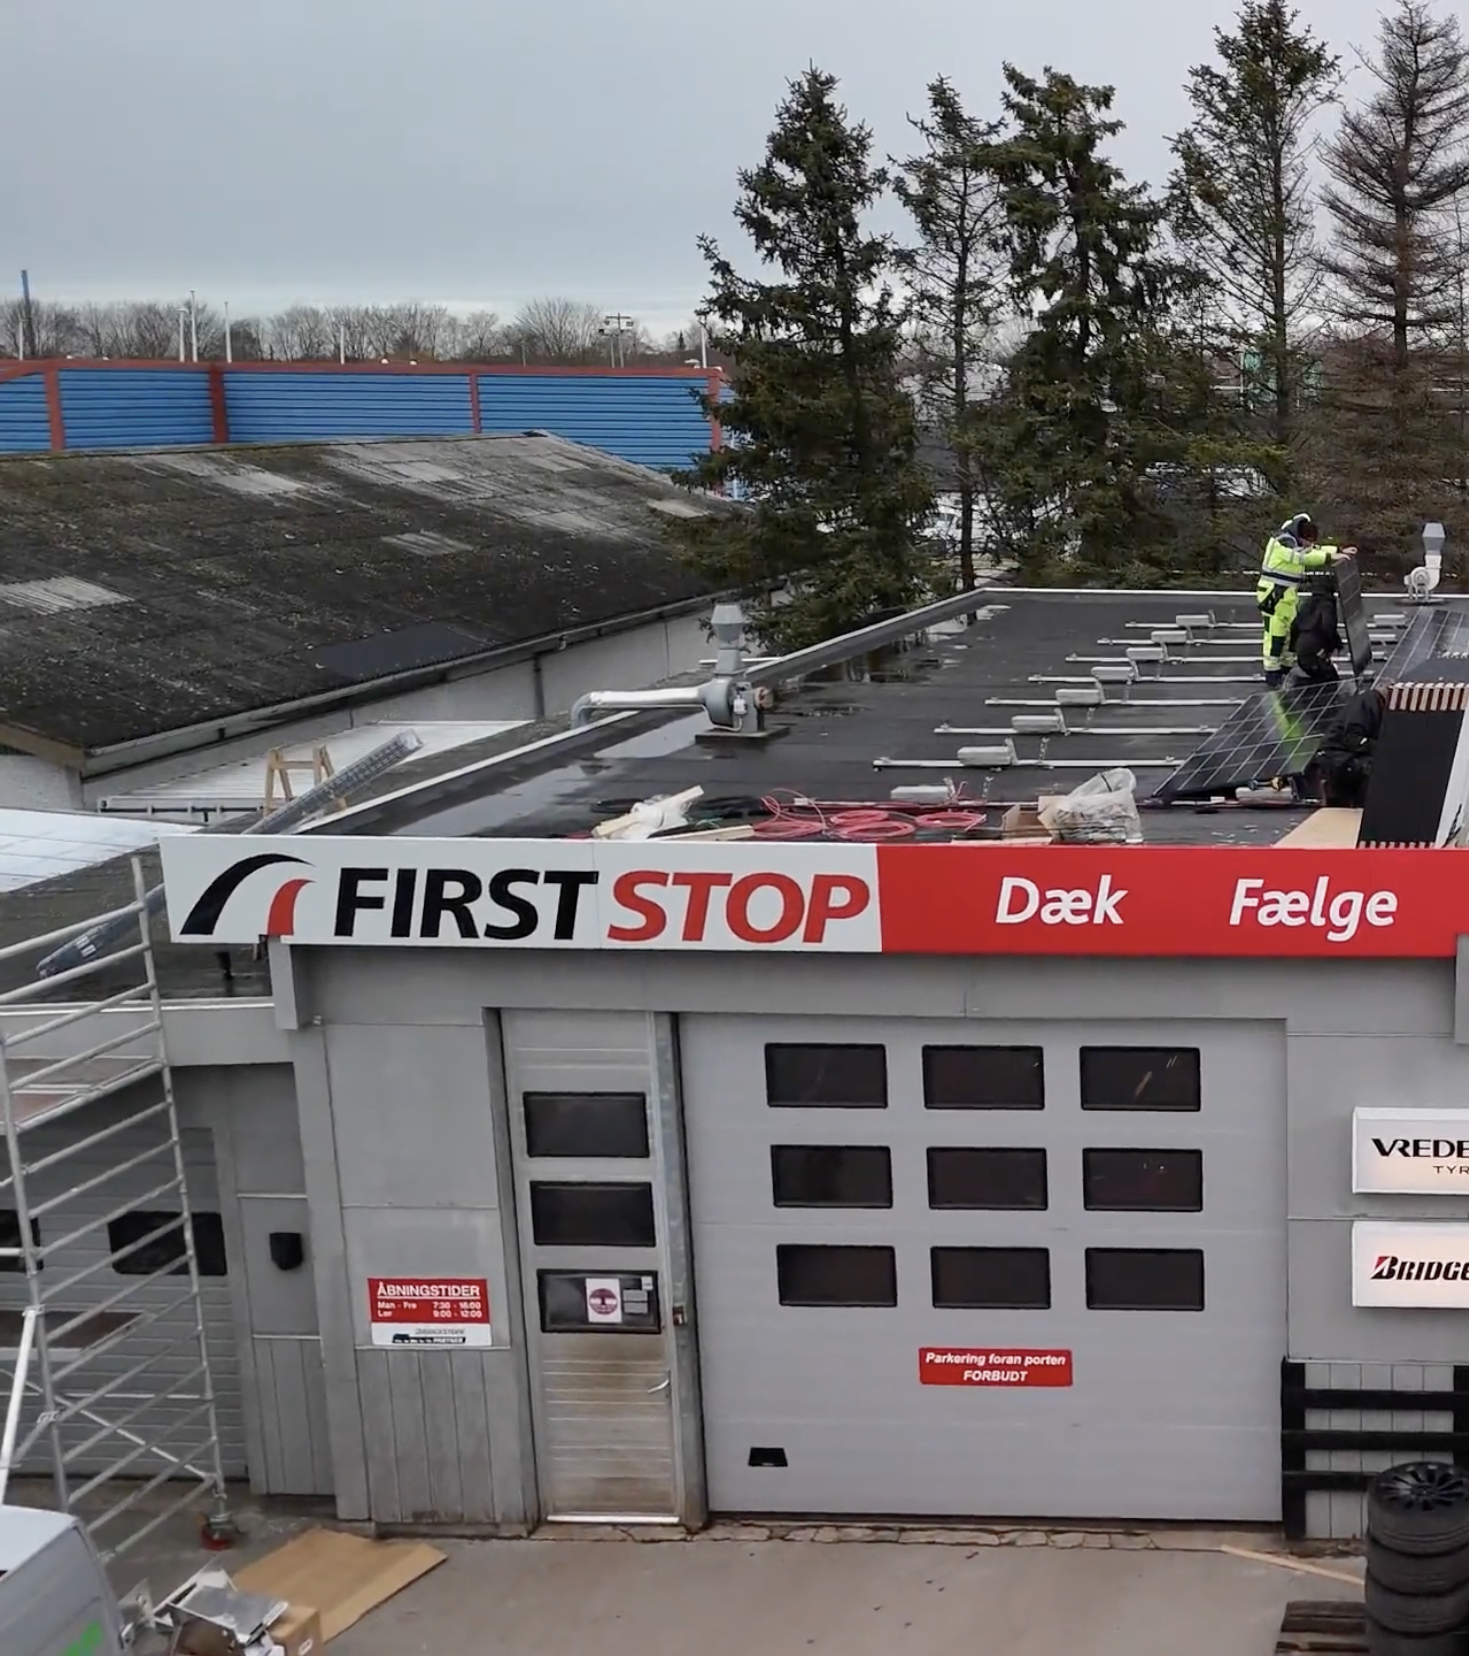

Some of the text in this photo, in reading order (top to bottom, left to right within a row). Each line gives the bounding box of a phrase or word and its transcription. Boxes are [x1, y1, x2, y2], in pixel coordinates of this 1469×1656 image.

[995, 874, 1128, 925] Dæk
[1229, 875, 1398, 942] Fælge
[377, 1281, 480, 1297] ÅBNINGSTIDER
[925, 1352, 1066, 1367] Parkering foran porten
[963, 1370, 1028, 1382] FORBUDT
